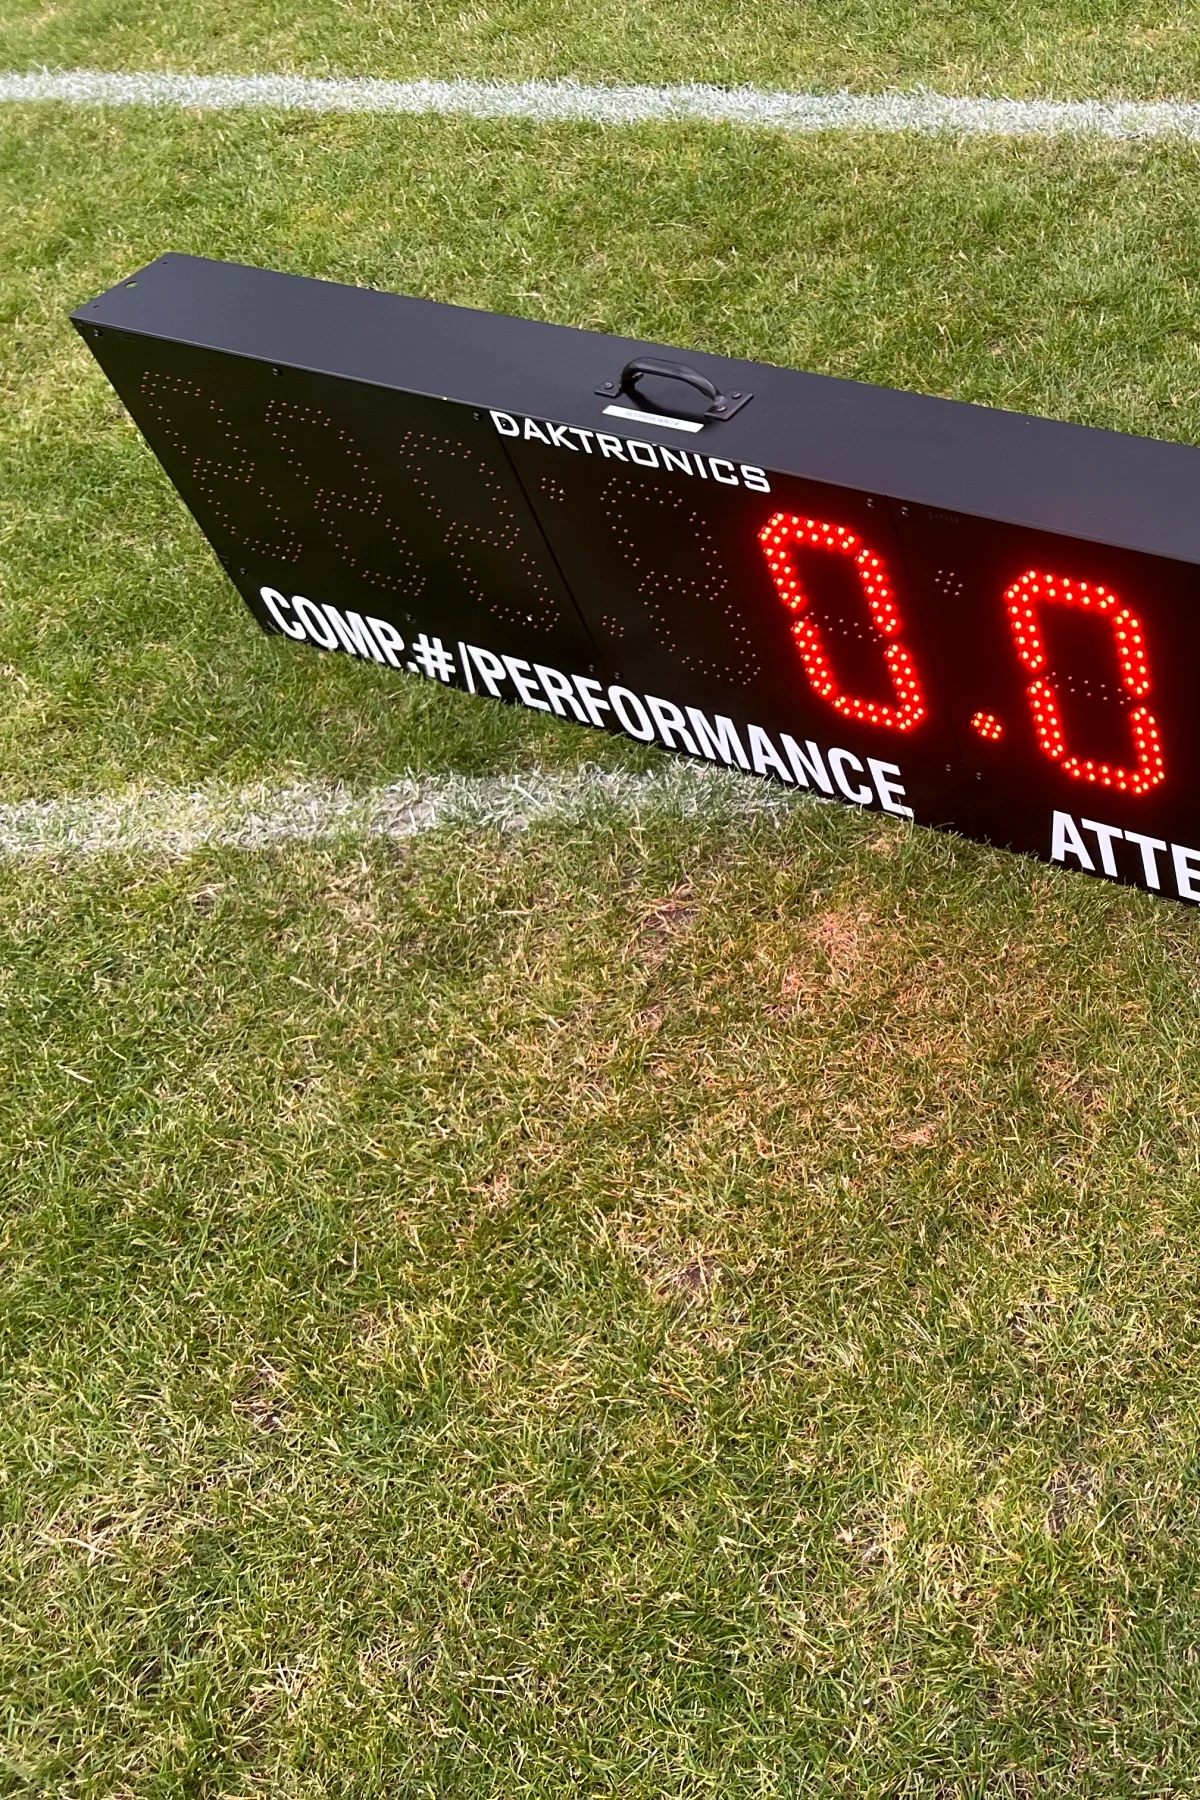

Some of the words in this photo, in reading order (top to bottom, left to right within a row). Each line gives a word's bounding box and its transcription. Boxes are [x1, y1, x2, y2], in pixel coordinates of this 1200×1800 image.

[489, 410, 770, 493] DAKTRONICS
[259, 586, 914, 818] COMP.#/PERFORMANCE
[758, 510, 1166, 797] 0.0
